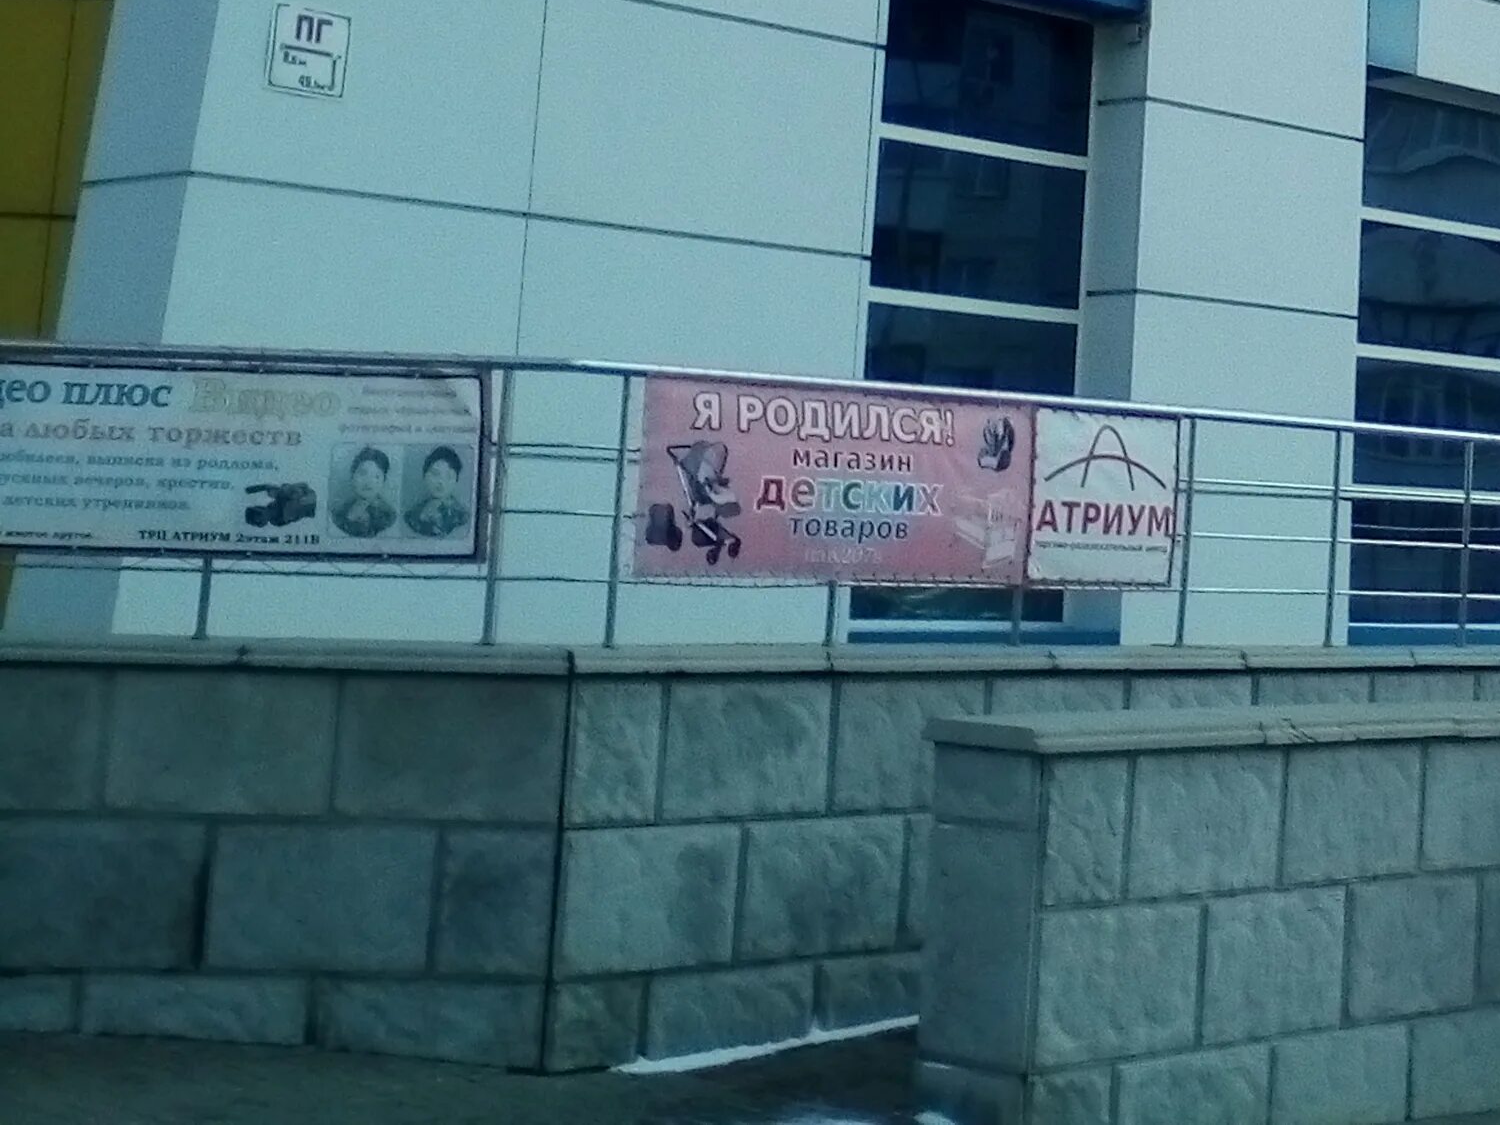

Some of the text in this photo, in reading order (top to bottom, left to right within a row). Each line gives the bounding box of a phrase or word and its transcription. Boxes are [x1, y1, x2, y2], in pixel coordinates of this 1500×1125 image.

[296, 14, 333, 44] ПГ
[61, 380, 173, 407] плюс
[24, 418, 136, 441] любых
[147, 426, 302, 448] торжеств
[690, 392, 956, 447] Я РОДИЛСЯ!
[792, 447, 912, 473] магазин
[755, 474, 945, 517] детских
[789, 517, 908, 544] товаров
[1036, 499, 1174, 539] АТРИУМ
[172, 530, 231, 543] АТРИУМ
